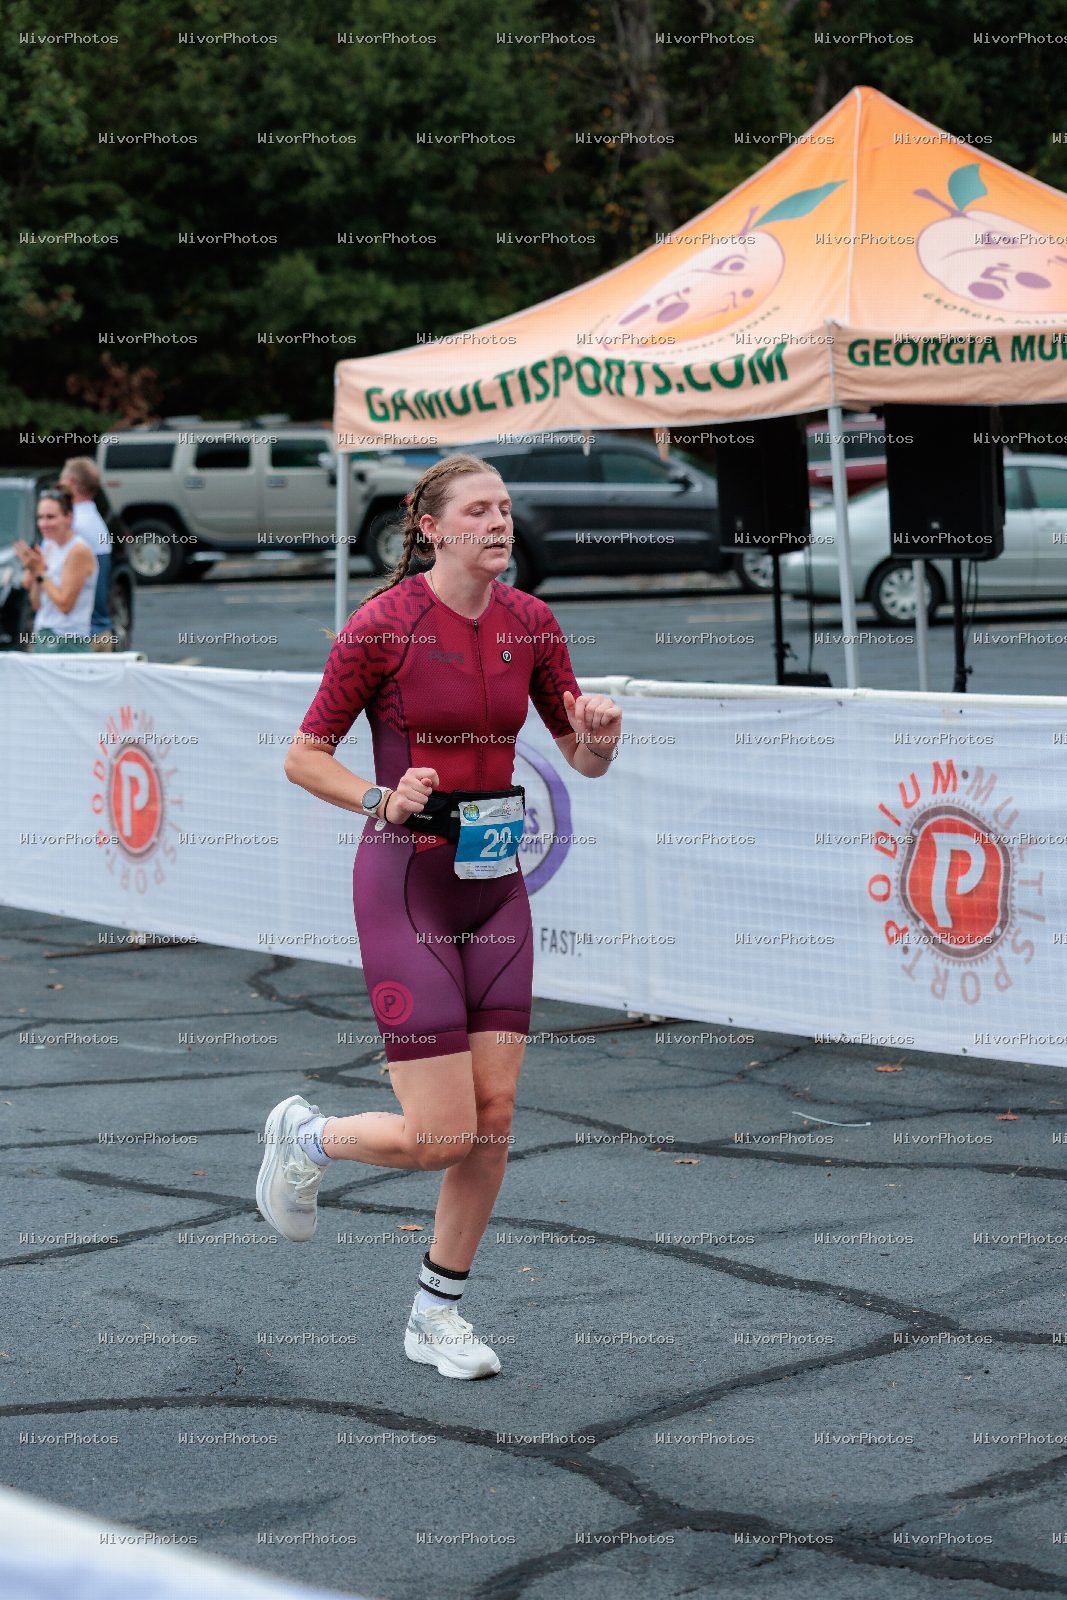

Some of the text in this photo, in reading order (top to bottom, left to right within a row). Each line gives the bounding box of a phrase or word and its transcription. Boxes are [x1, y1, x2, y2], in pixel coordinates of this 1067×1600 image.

[848, 334, 1002, 367] GEORGIA
[365, 342, 788, 422] GAMULTISPORTS.COM
[479, 826, 513, 858] 22
[931, 831, 987, 929] P
[428, 1276, 441, 1288] 22
